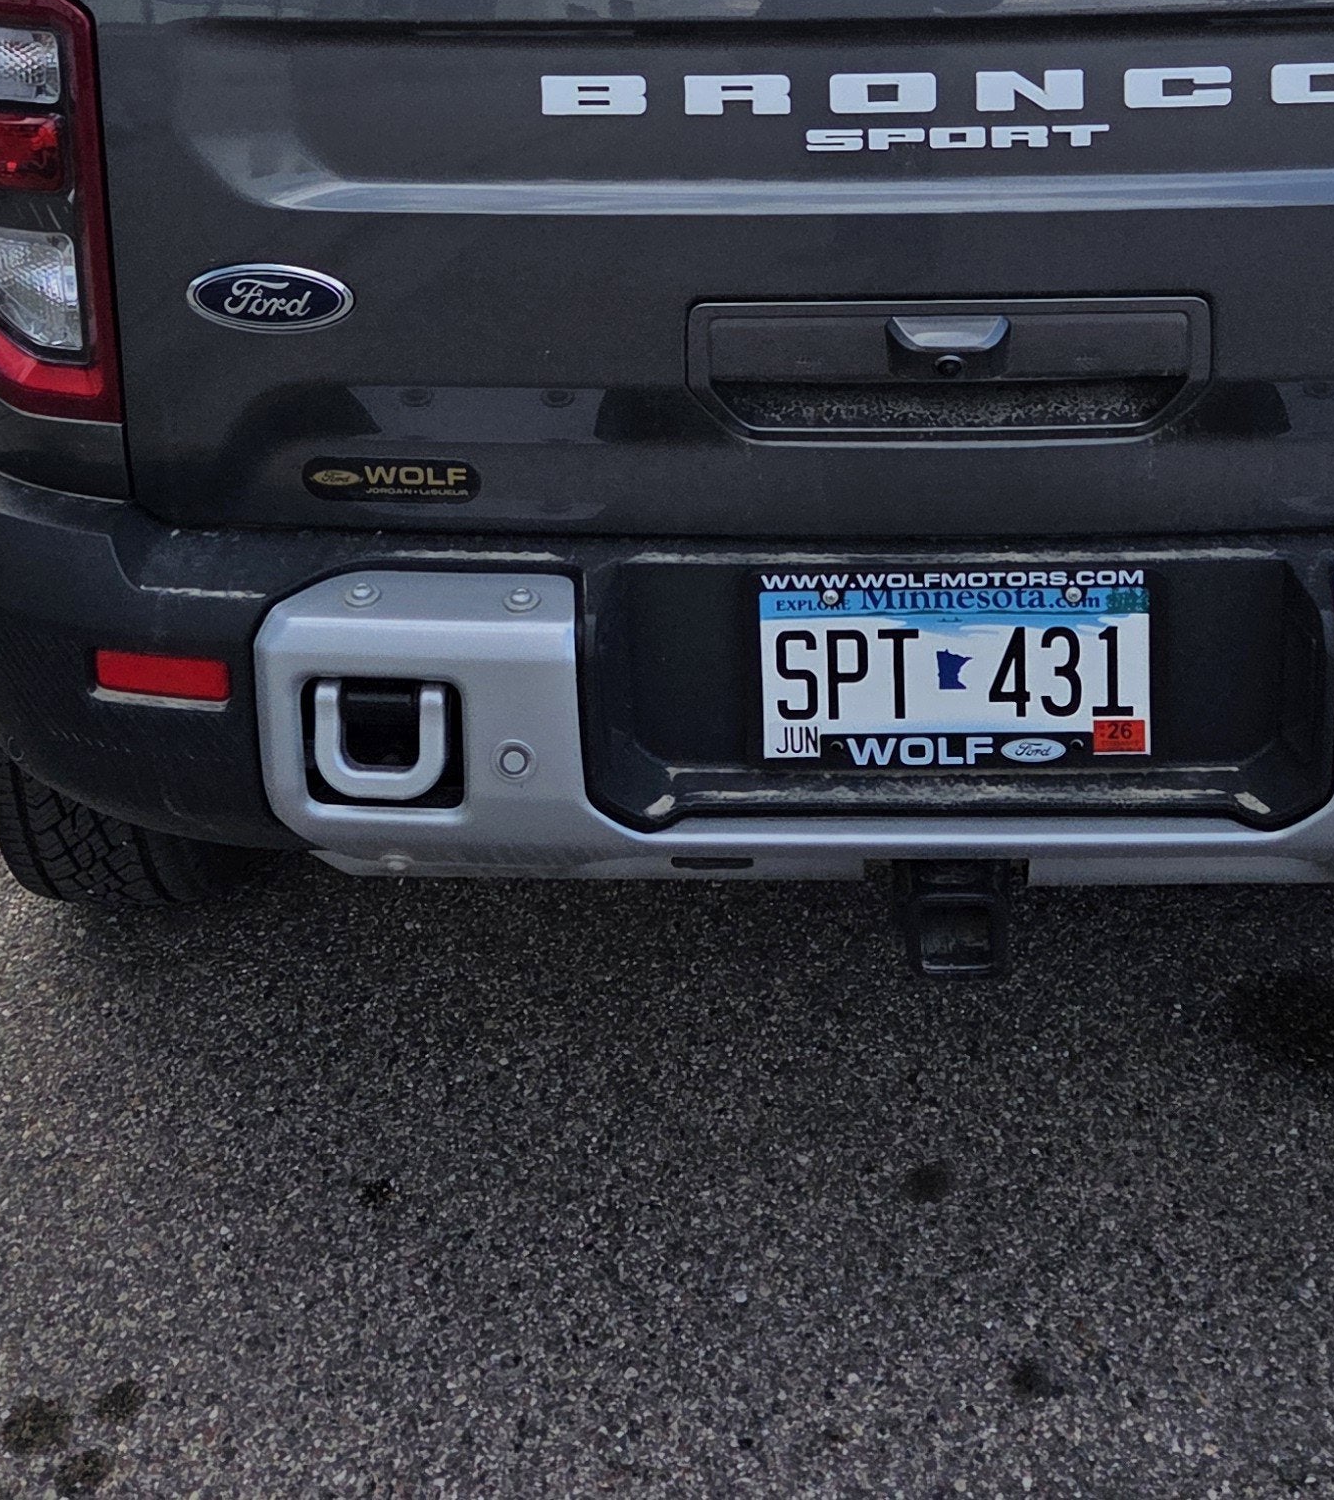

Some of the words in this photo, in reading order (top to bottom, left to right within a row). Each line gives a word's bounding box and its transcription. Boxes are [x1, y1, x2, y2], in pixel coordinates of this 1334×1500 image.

[805, 124, 1110, 152] SPORT
[223, 278, 312, 317] Ford
[321, 470, 351, 484] Ford
[364, 465, 467, 487] WOLF
[366, 486, 413, 496] JORDAN
[760, 570, 1144, 590] WWW.WOLFMOTORS.COM
[776, 628, 919, 720] SPT
[989, 625, 1134, 717] 431
[775, 726, 819, 754] JUN
[1107, 723, 1133, 740] 26
[846, 736, 994, 766] WOLF
[1014, 738, 1052, 757] Ford
